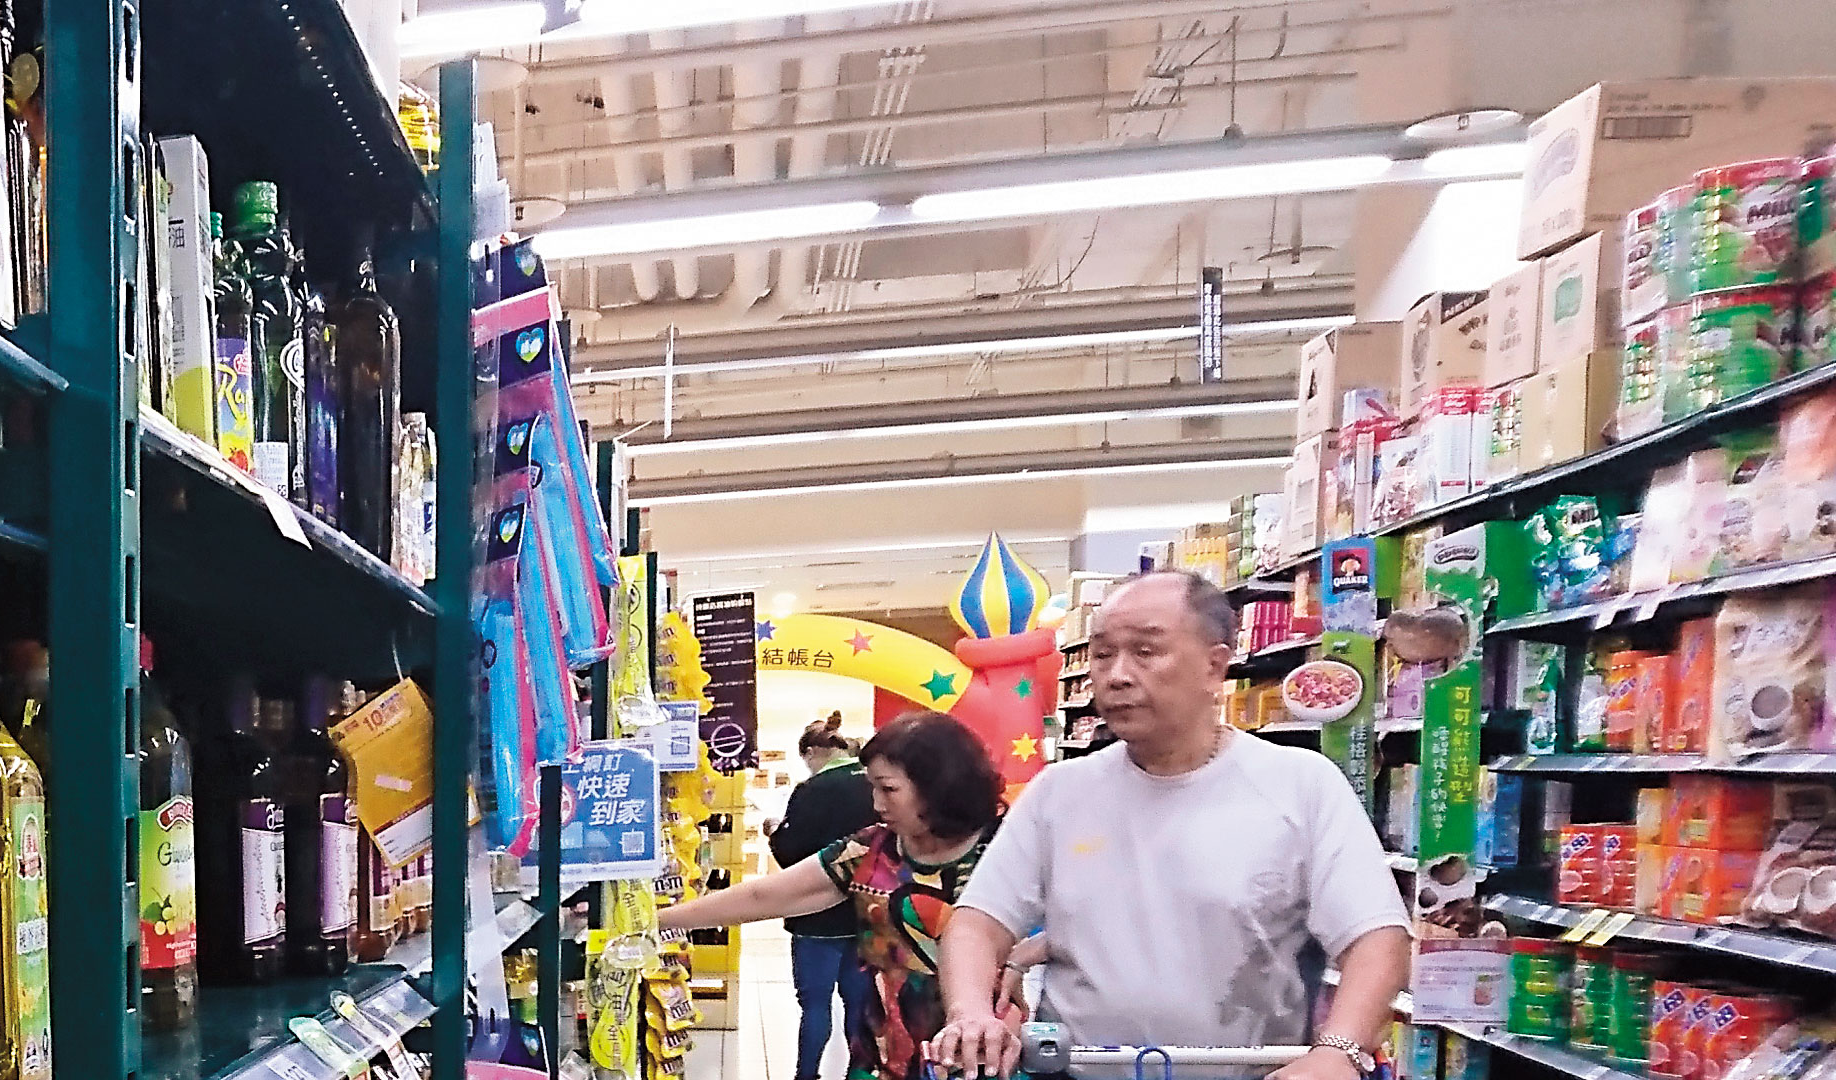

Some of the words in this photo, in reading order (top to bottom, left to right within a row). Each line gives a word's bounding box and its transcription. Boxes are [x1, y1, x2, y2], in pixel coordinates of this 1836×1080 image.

[1333, 576, 1368, 588] QUAKER
[762, 648, 834, 668] 結帳台
[577, 772, 630, 799] 快速
[589, 800, 646, 826] 到家
